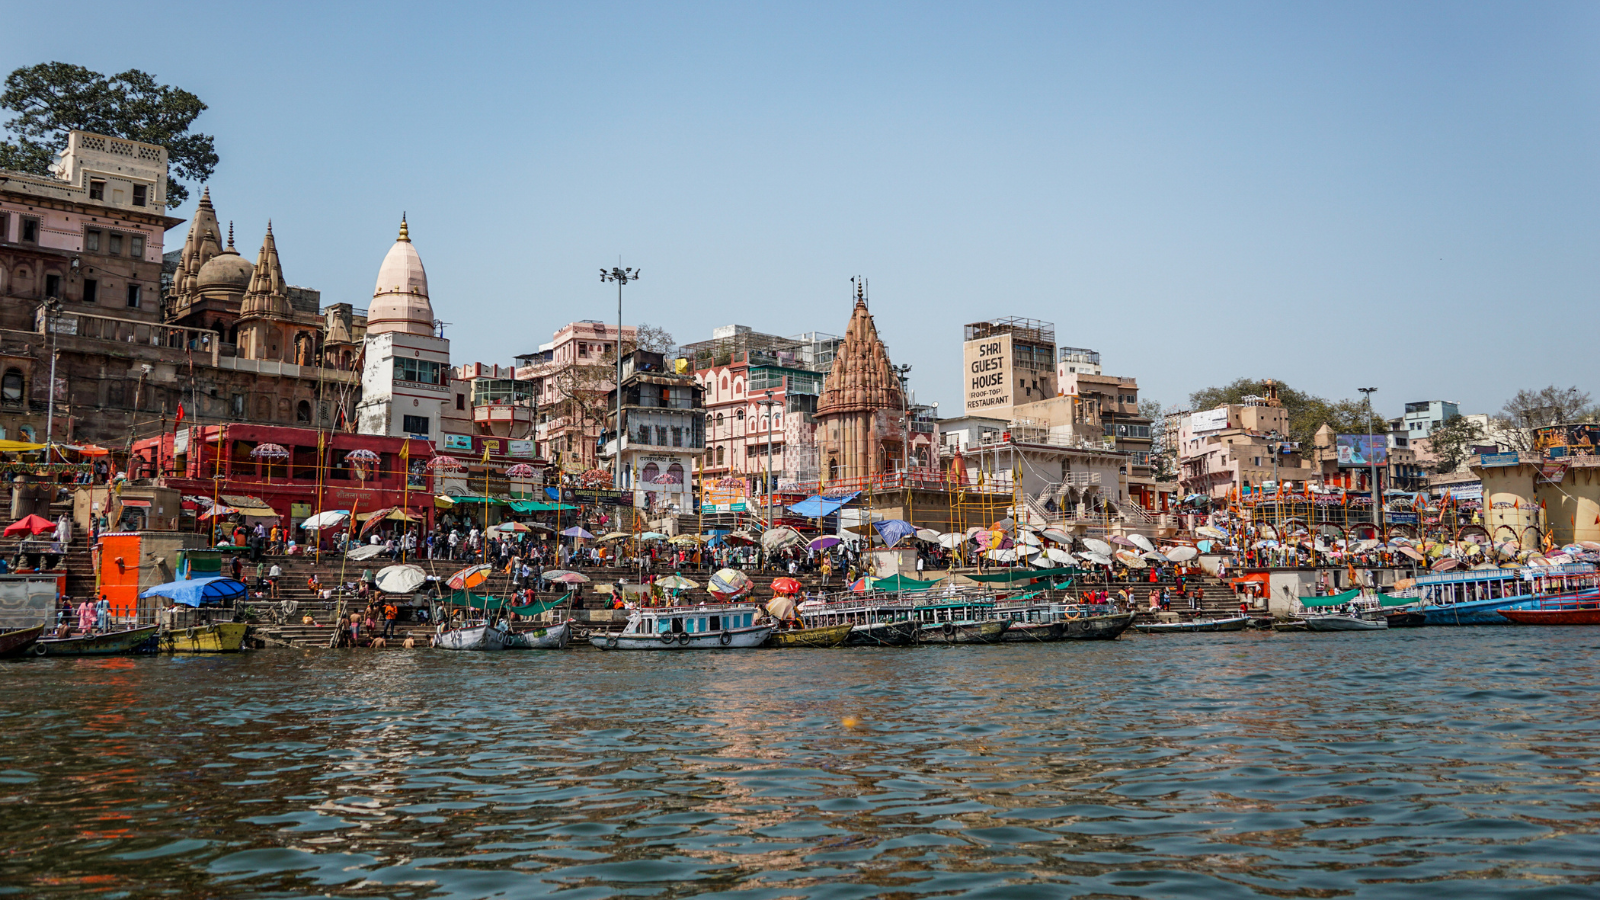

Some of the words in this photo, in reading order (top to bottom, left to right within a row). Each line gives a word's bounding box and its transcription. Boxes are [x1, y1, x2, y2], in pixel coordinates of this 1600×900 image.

[980, 342, 1001, 357] SHRI
[971, 357, 1004, 373] GUEST
[972, 372, 1003, 389] HOUSE
[968, 387, 1003, 399] (ROOF-TOP)
[967, 395, 1009, 409] RESTAURANT
